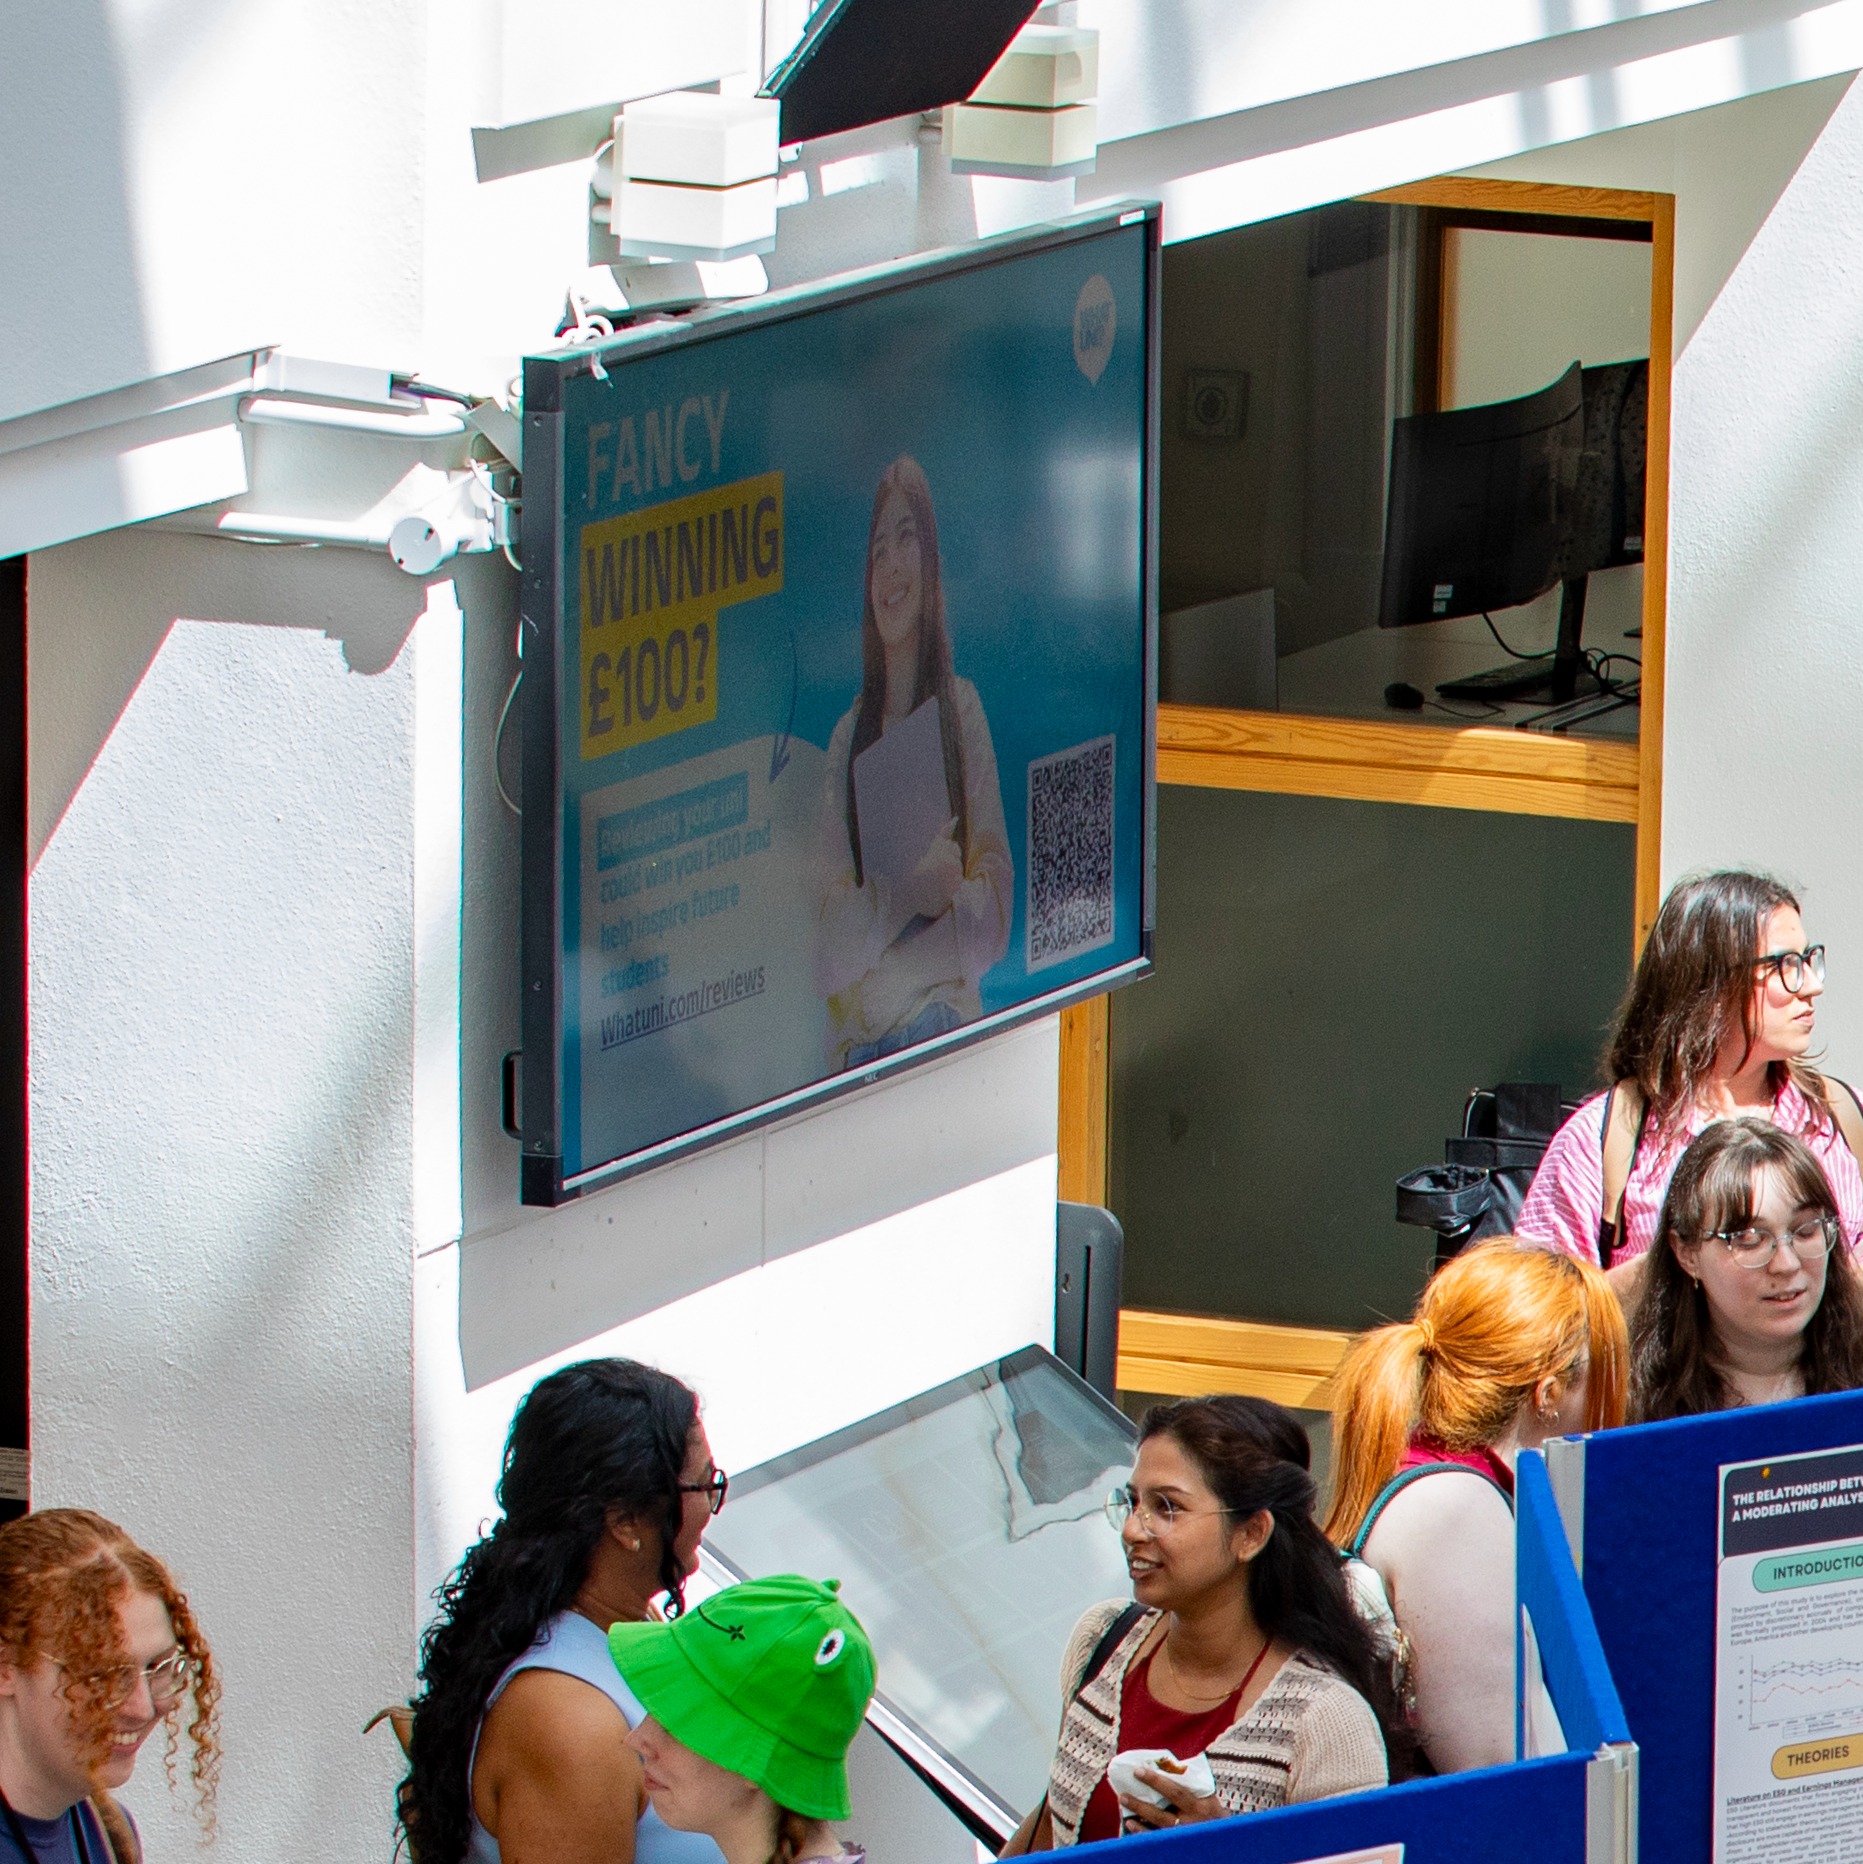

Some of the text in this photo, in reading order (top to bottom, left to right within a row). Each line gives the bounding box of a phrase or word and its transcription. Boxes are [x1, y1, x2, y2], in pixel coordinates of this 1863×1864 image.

[586, 390, 729, 509] FANCY
[584, 494, 780, 629] WINNING
[586, 622, 712, 738] £100?
[1731, 1509, 1741, 1523] A
[1742, 1497, 1819, 1521] MODERATING
[1732, 1491, 1755, 1506] THE
[1755, 1479, 1838, 1503] RELATIONSHIP
[1786, 1744, 1850, 1767] THEORIES
